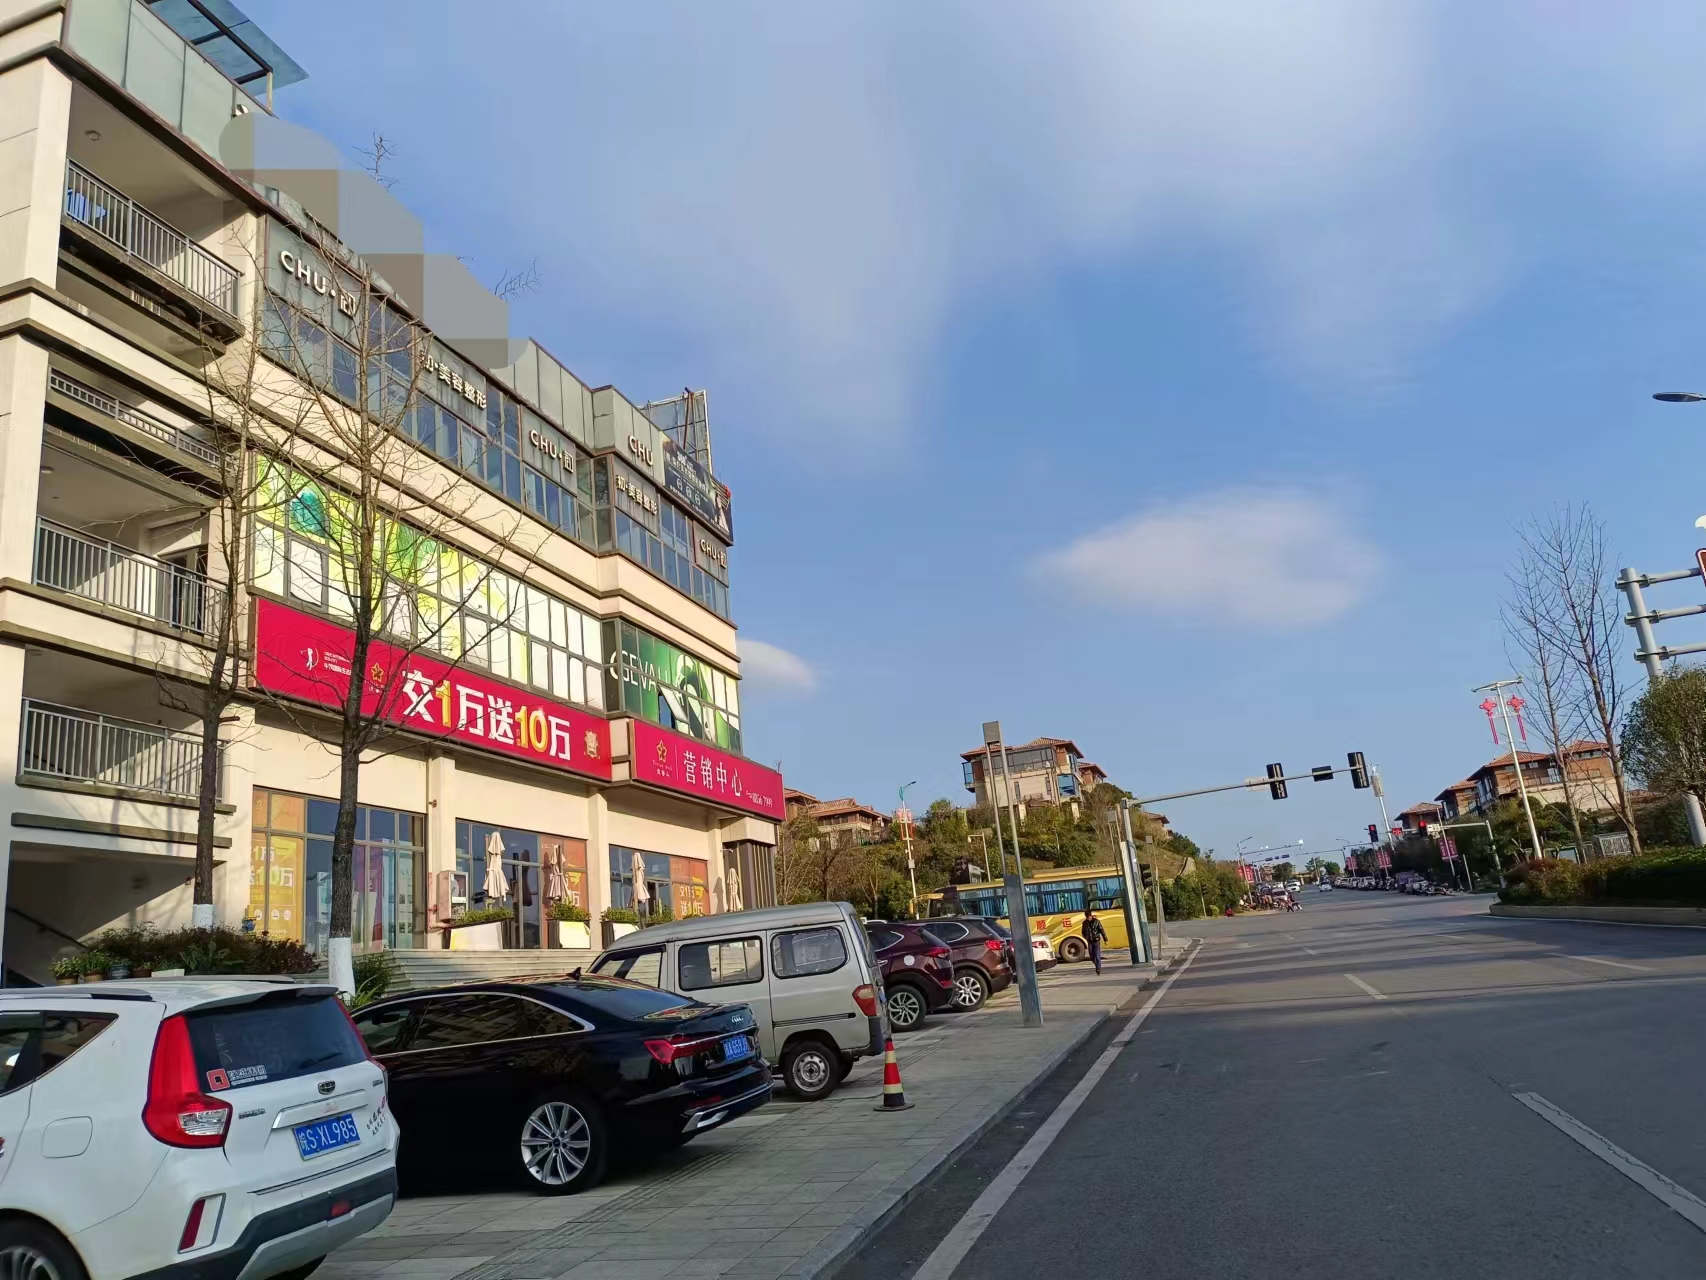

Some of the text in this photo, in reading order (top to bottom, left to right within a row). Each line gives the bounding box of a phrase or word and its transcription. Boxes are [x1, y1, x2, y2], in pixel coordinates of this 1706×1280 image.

[629, 435, 654, 466] CHU
[683, 750, 743, 797] 营销中心
